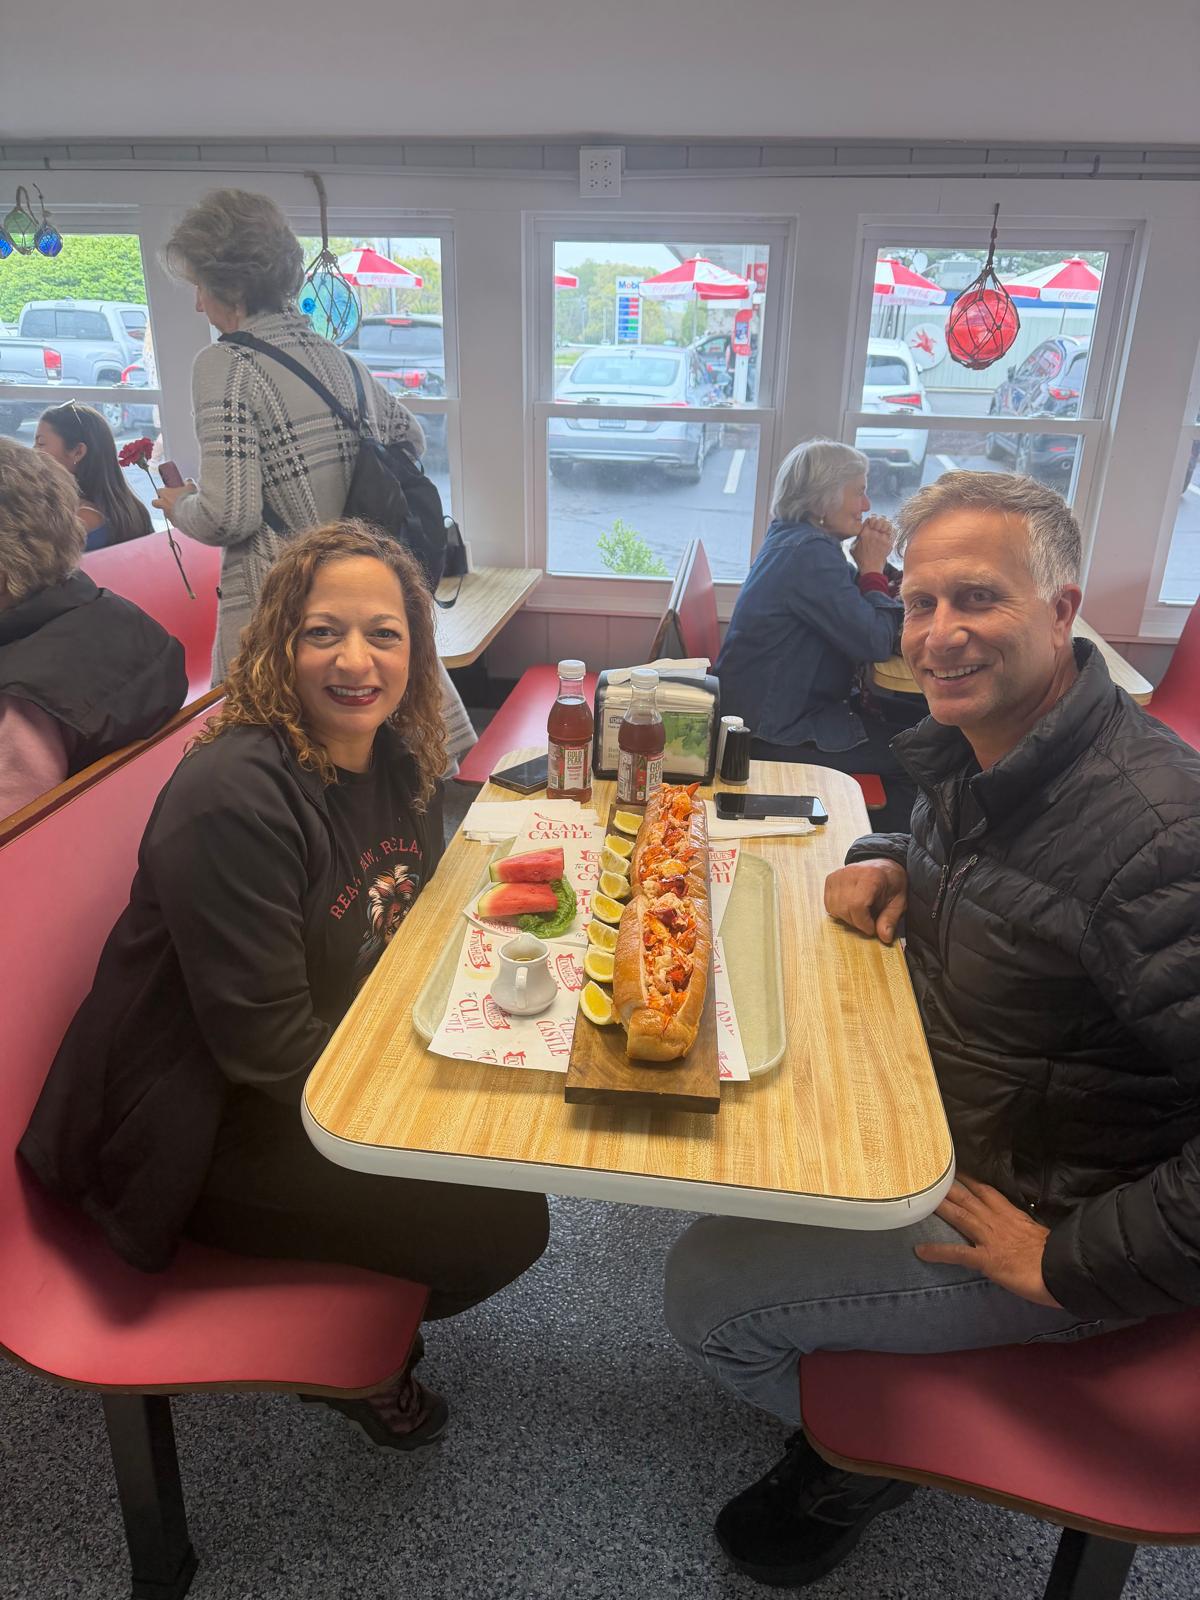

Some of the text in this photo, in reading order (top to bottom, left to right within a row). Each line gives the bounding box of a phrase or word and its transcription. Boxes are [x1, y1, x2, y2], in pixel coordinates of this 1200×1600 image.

[618, 281, 640, 289] Mobi
[536, 821, 584, 832] CLAM
[528, 831, 592, 840] CASTLE
[458, 999, 485, 1030] CLAM
